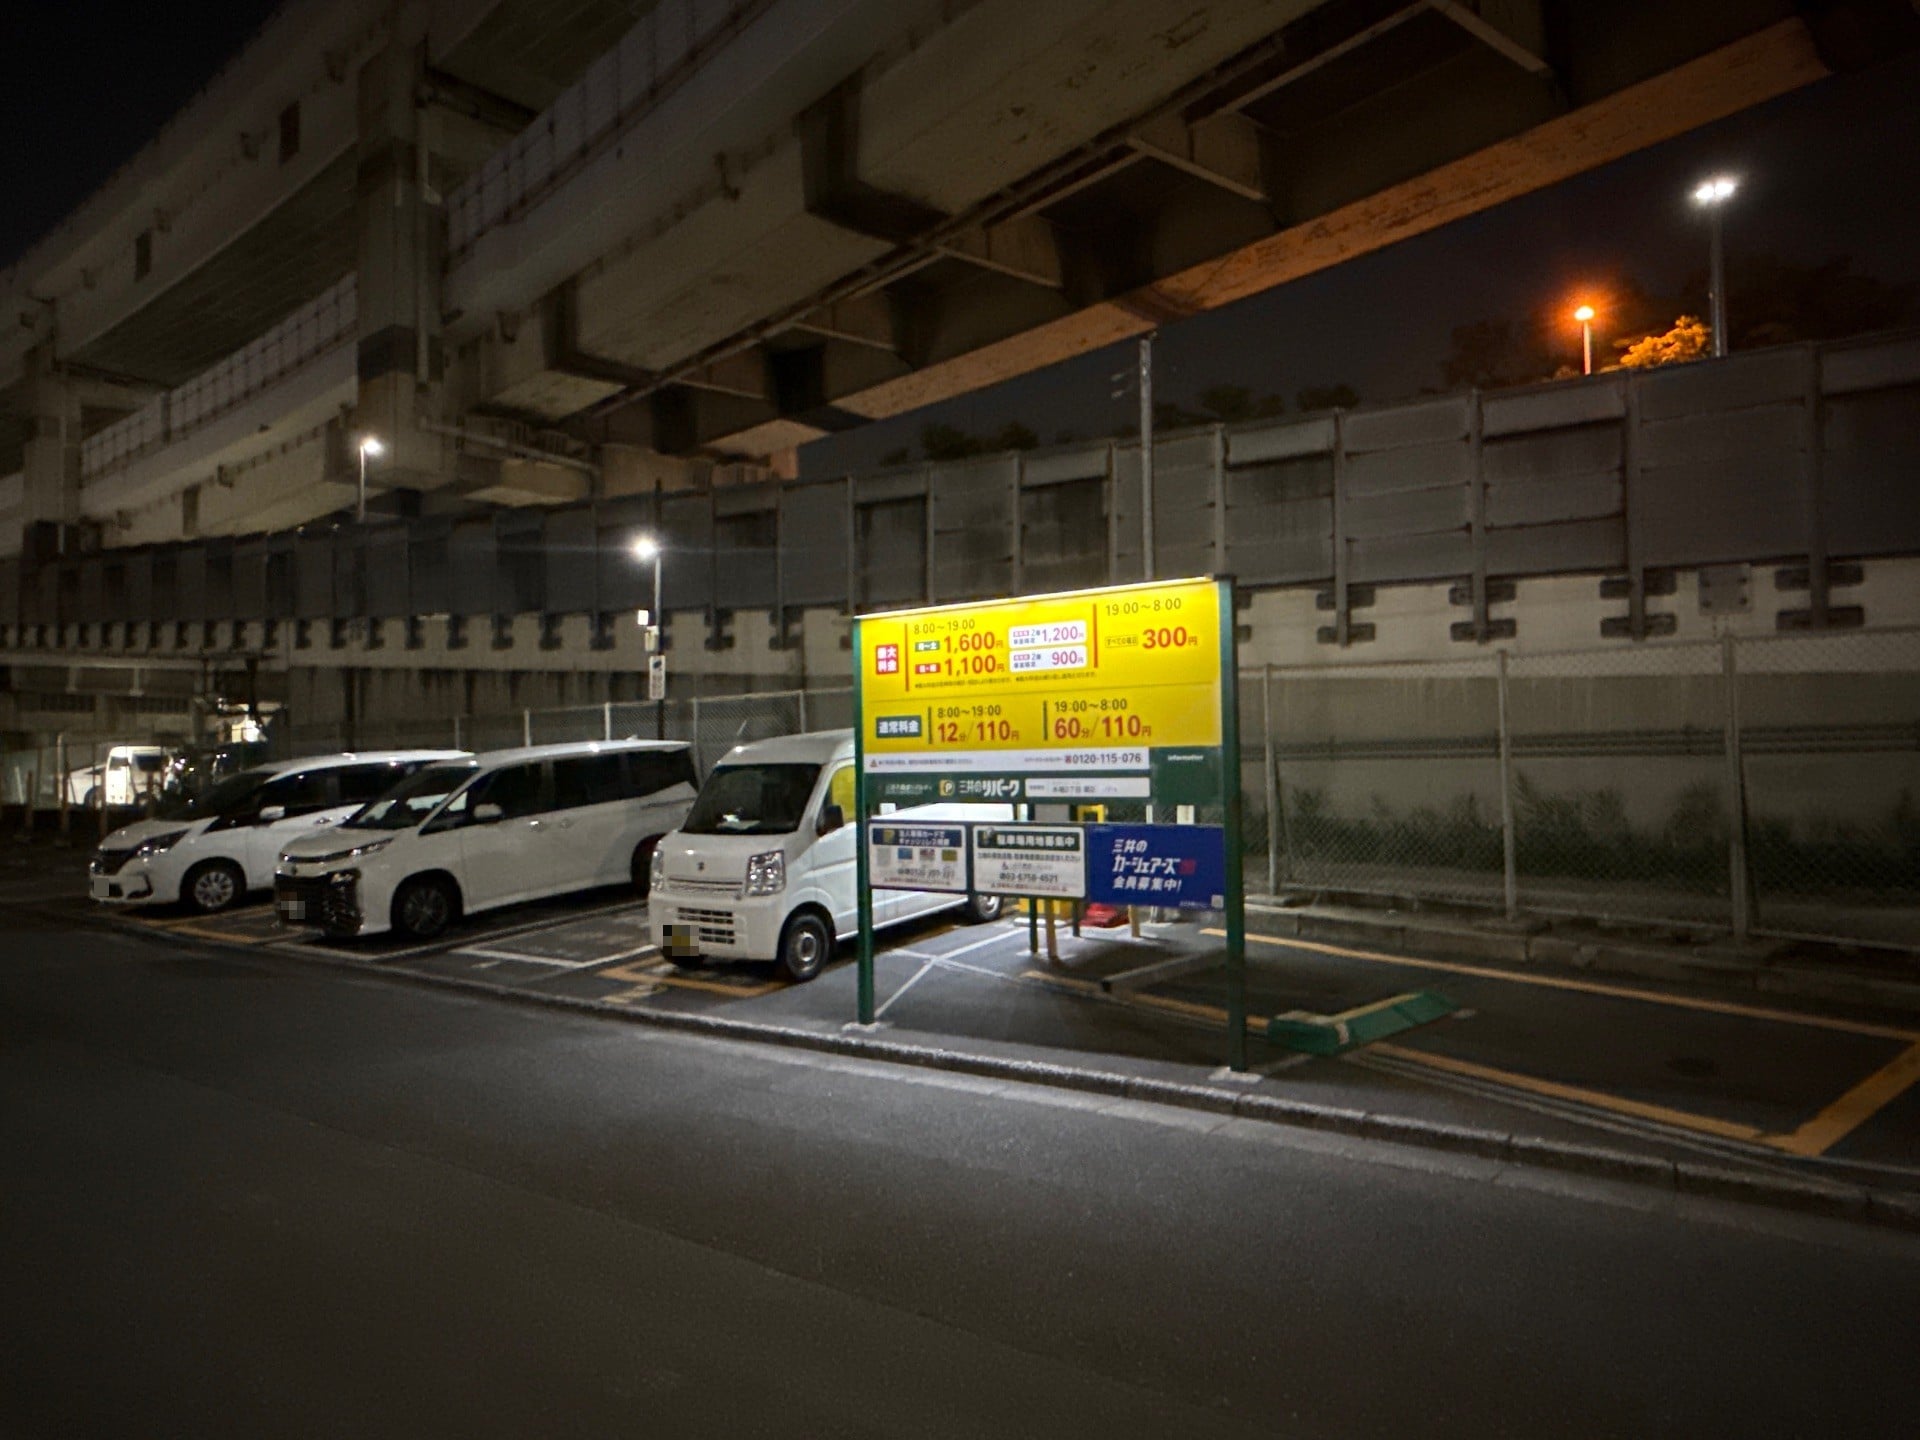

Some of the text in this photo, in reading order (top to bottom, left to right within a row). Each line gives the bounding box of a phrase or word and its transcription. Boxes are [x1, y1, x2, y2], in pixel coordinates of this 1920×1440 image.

[1143, 626, 1198, 649] 300円
[1073, 753, 1142, 764] 0120-115-076
[1112, 839, 1148, 853] 三井の
